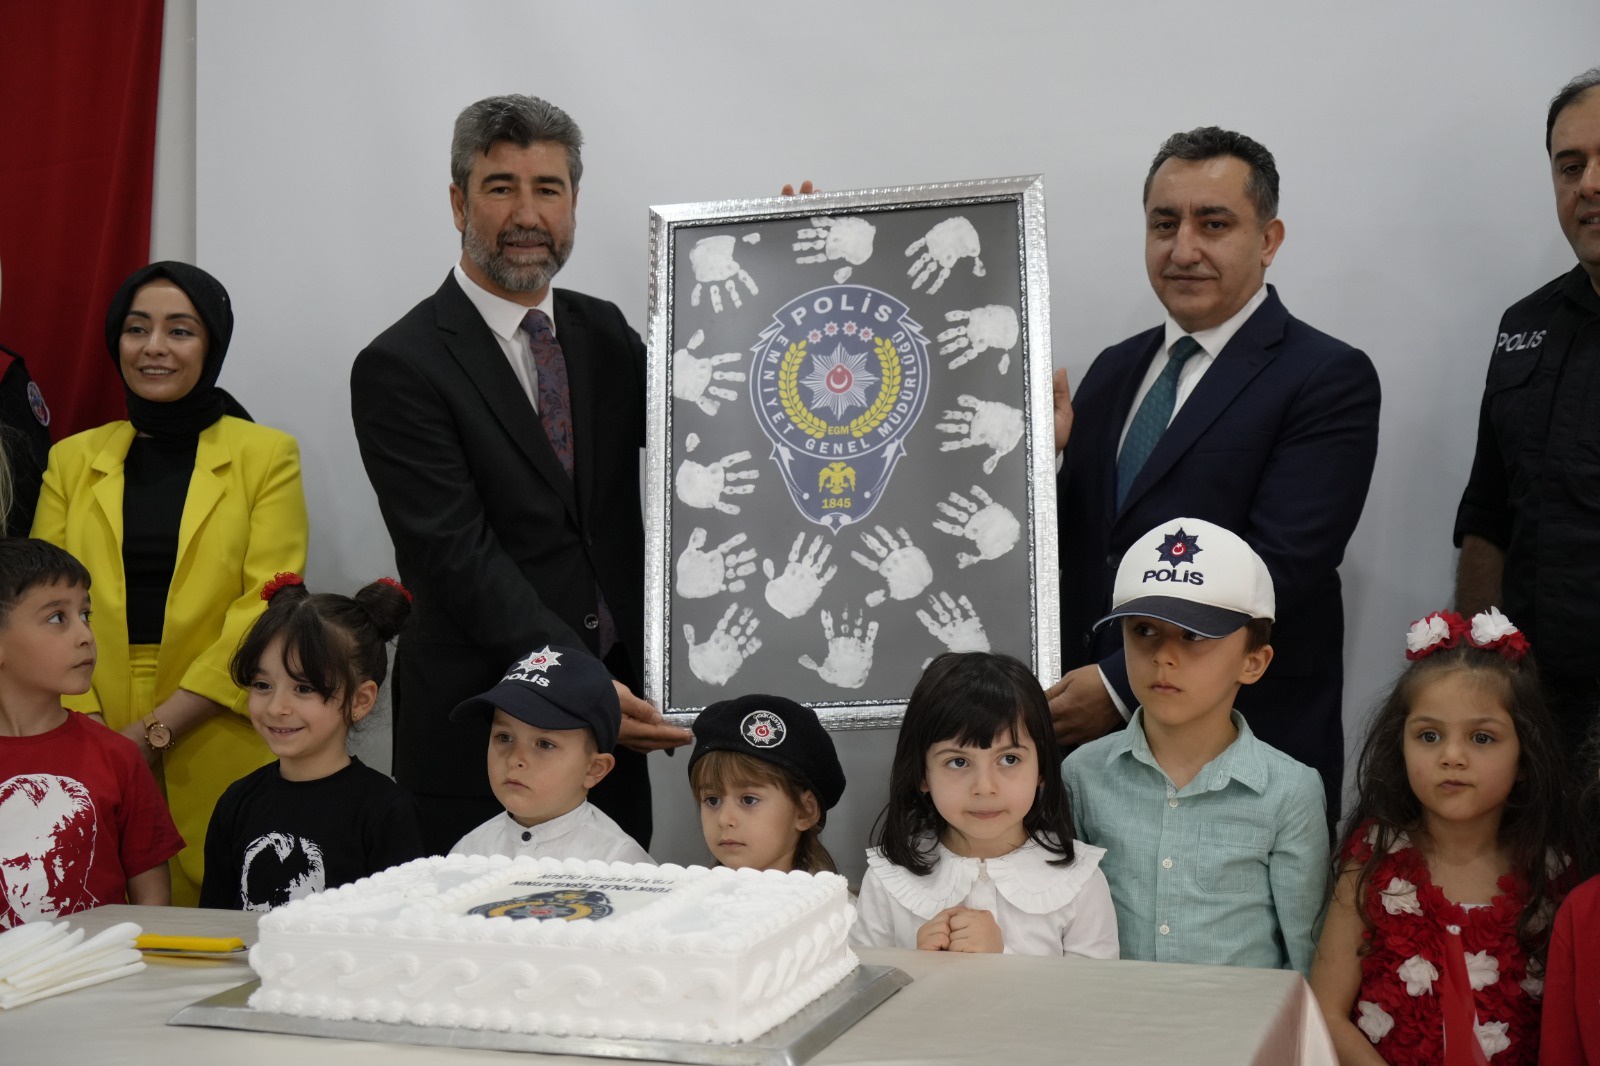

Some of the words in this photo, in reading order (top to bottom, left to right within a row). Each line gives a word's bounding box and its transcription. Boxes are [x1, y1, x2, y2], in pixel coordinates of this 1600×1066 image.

[790, 293, 892, 326] POLİS
[1496, 329, 1547, 354] POLİS
[763, 334, 795, 434] EMNİYET
[805, 438, 870, 454] GENEL
[877, 330, 917, 437] MÜDÜRLÜĞÜ
[827, 426, 849, 435] EGM
[821, 498, 851, 508] 1845
[1142, 569, 1204, 586] POLİS
